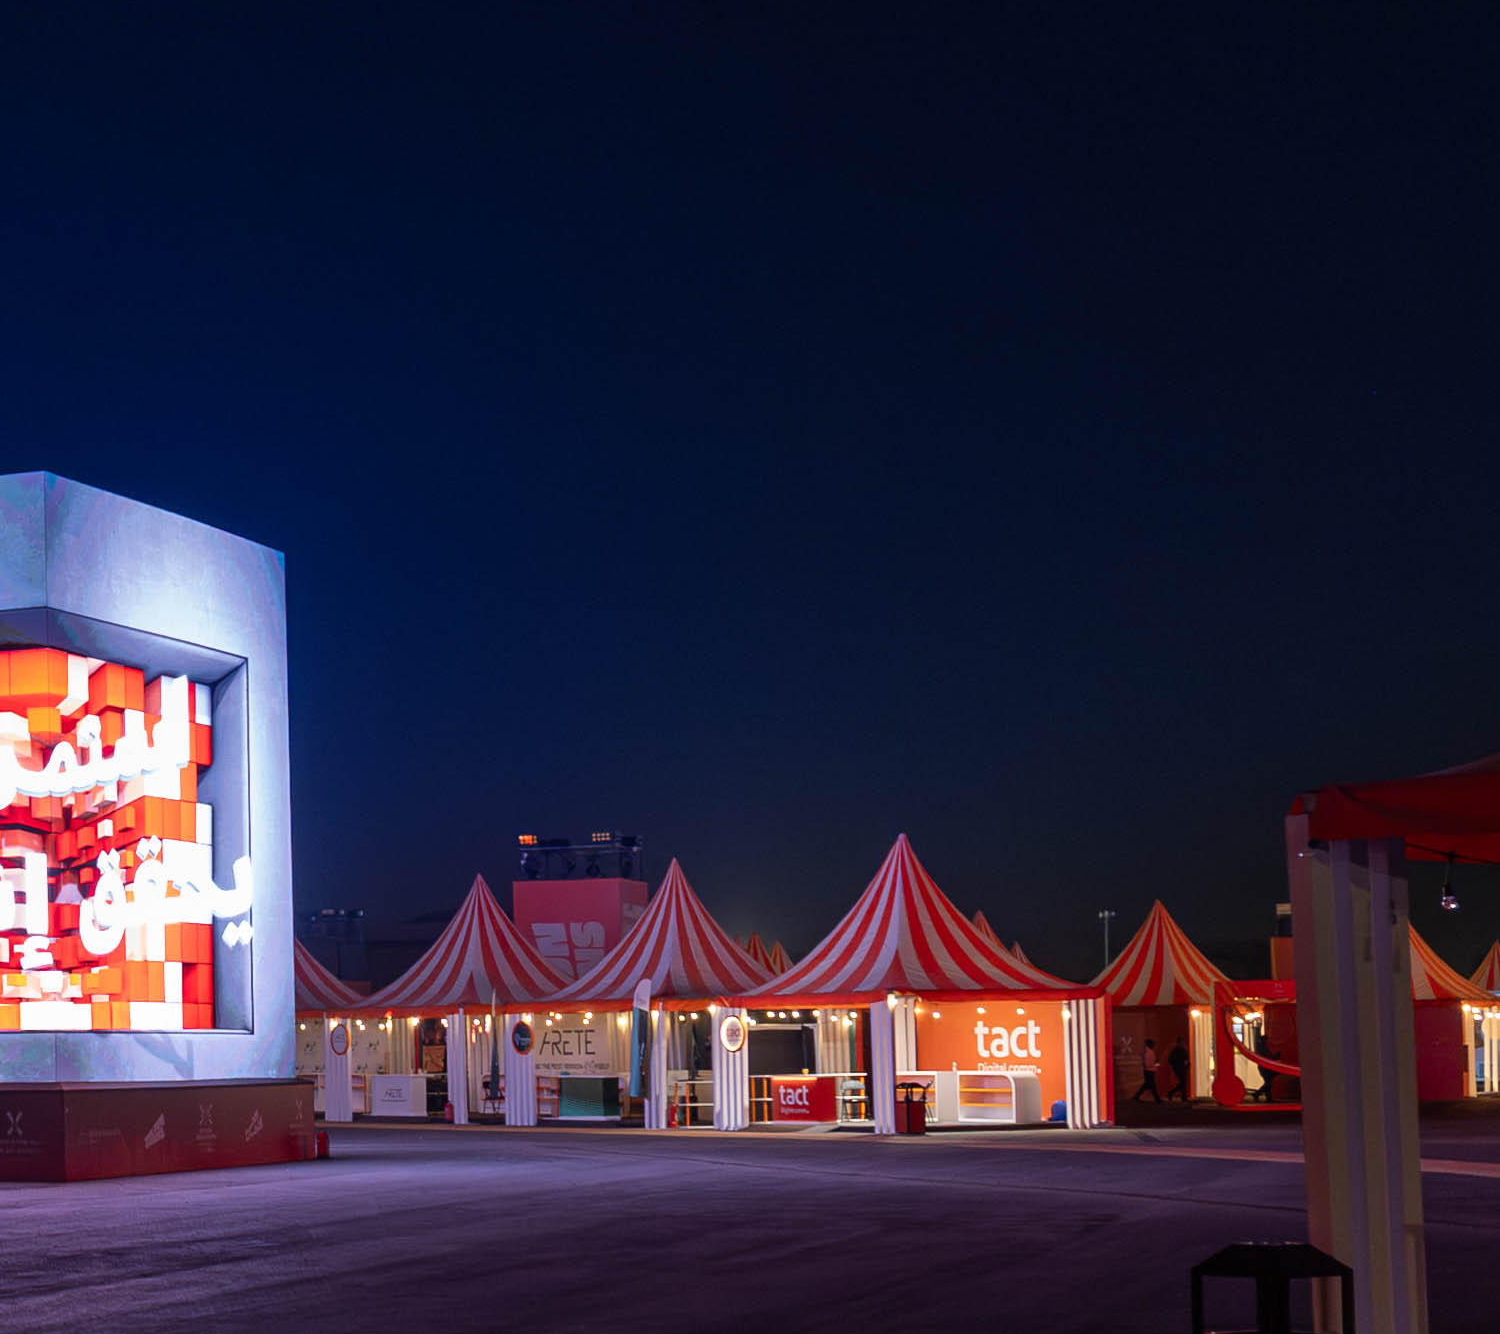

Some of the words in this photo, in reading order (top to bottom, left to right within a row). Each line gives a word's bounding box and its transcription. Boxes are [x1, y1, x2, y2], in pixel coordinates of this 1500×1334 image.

[539, 1029, 596, 1056] ARETE
[974, 1019, 1042, 1058] tact
[778, 1084, 809, 1106] tact
